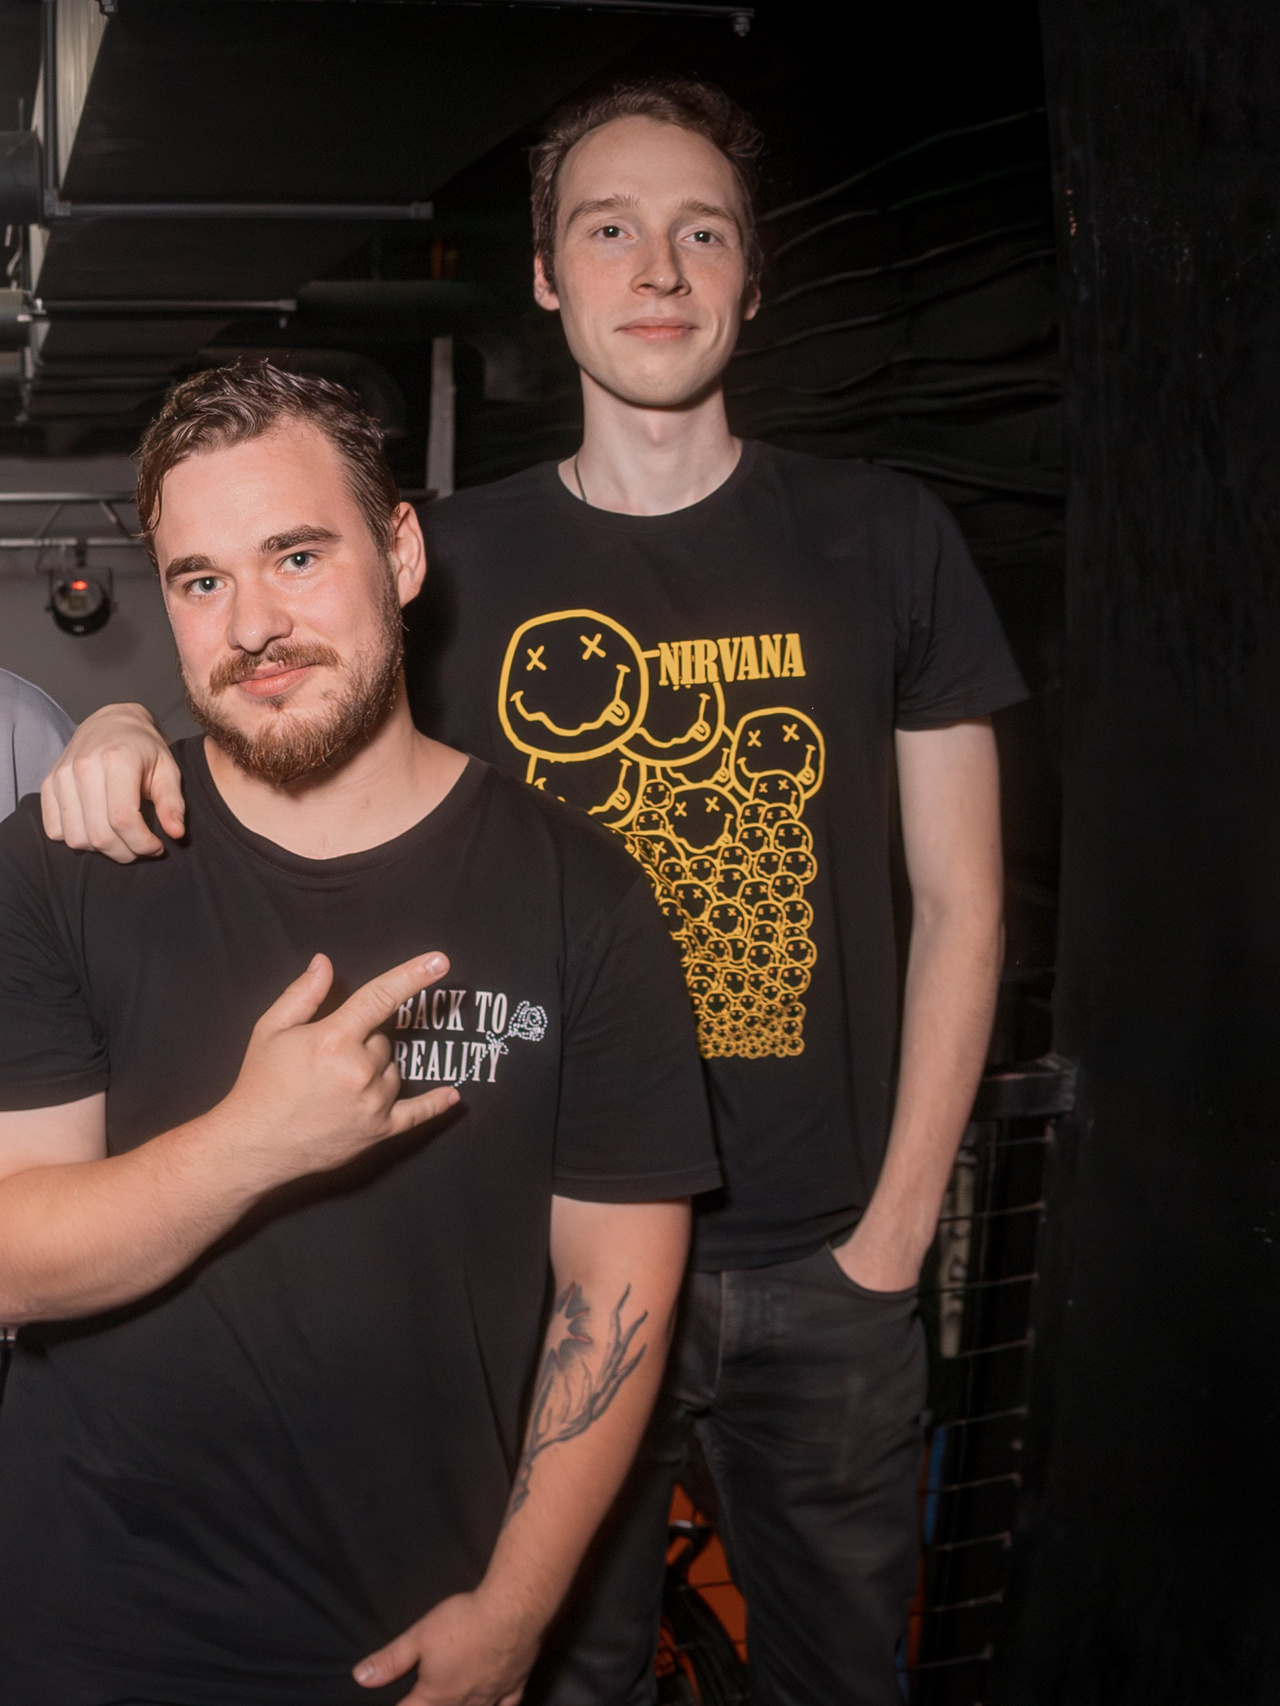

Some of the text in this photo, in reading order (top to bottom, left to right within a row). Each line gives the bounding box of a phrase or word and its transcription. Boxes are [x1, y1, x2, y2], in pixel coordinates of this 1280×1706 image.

[658, 633, 806, 686] NIRVANA
[395, 989, 508, 1034] BACK TO
[395, 1039, 503, 1083] REALITY
